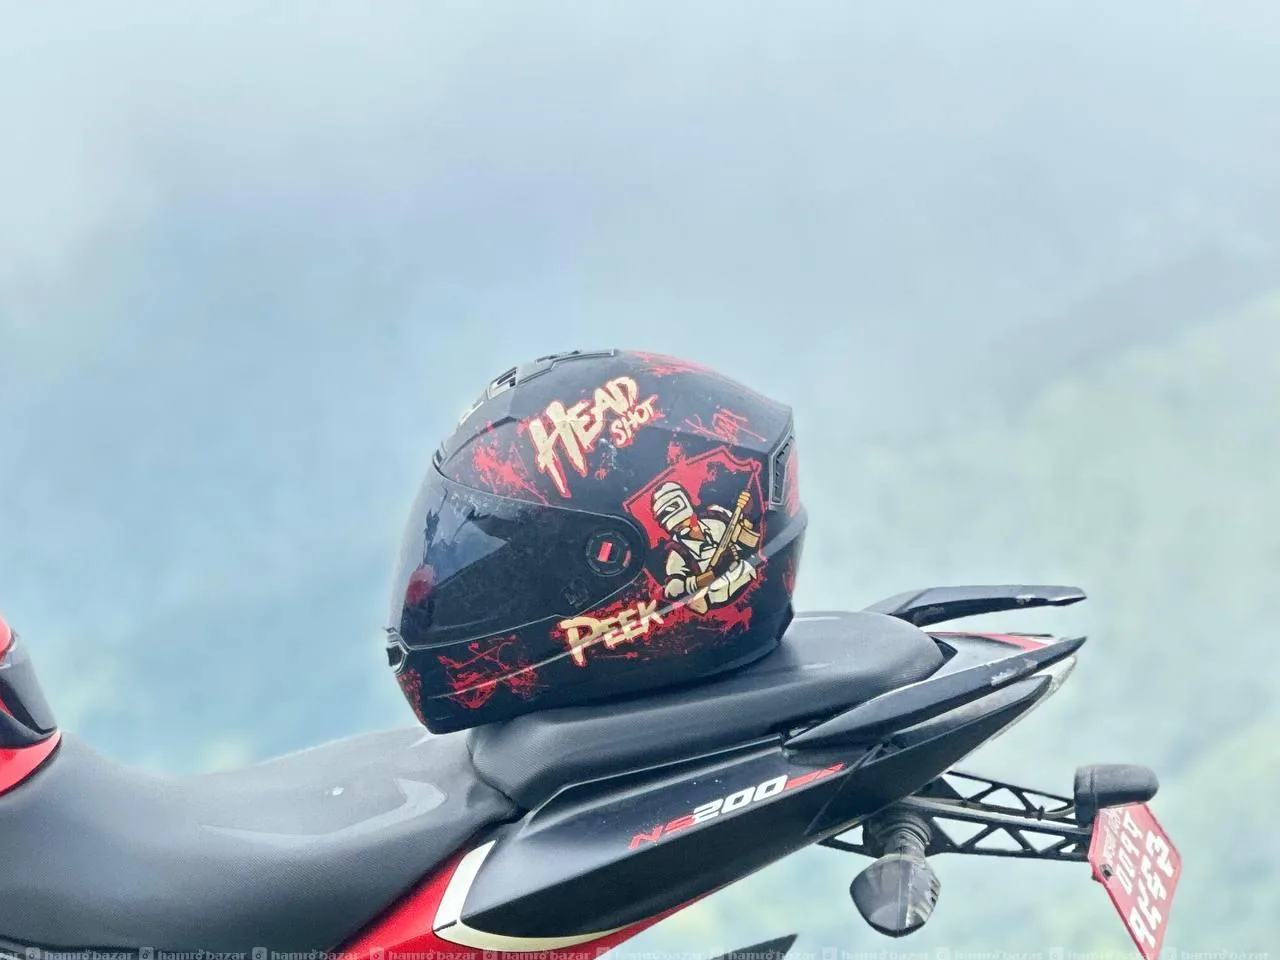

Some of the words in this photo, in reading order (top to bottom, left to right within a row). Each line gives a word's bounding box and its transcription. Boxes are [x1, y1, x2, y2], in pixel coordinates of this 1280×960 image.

[529, 376, 639, 498] HEAD
[610, 395, 658, 447] SHOT
[559, 599, 662, 668] PEEK
